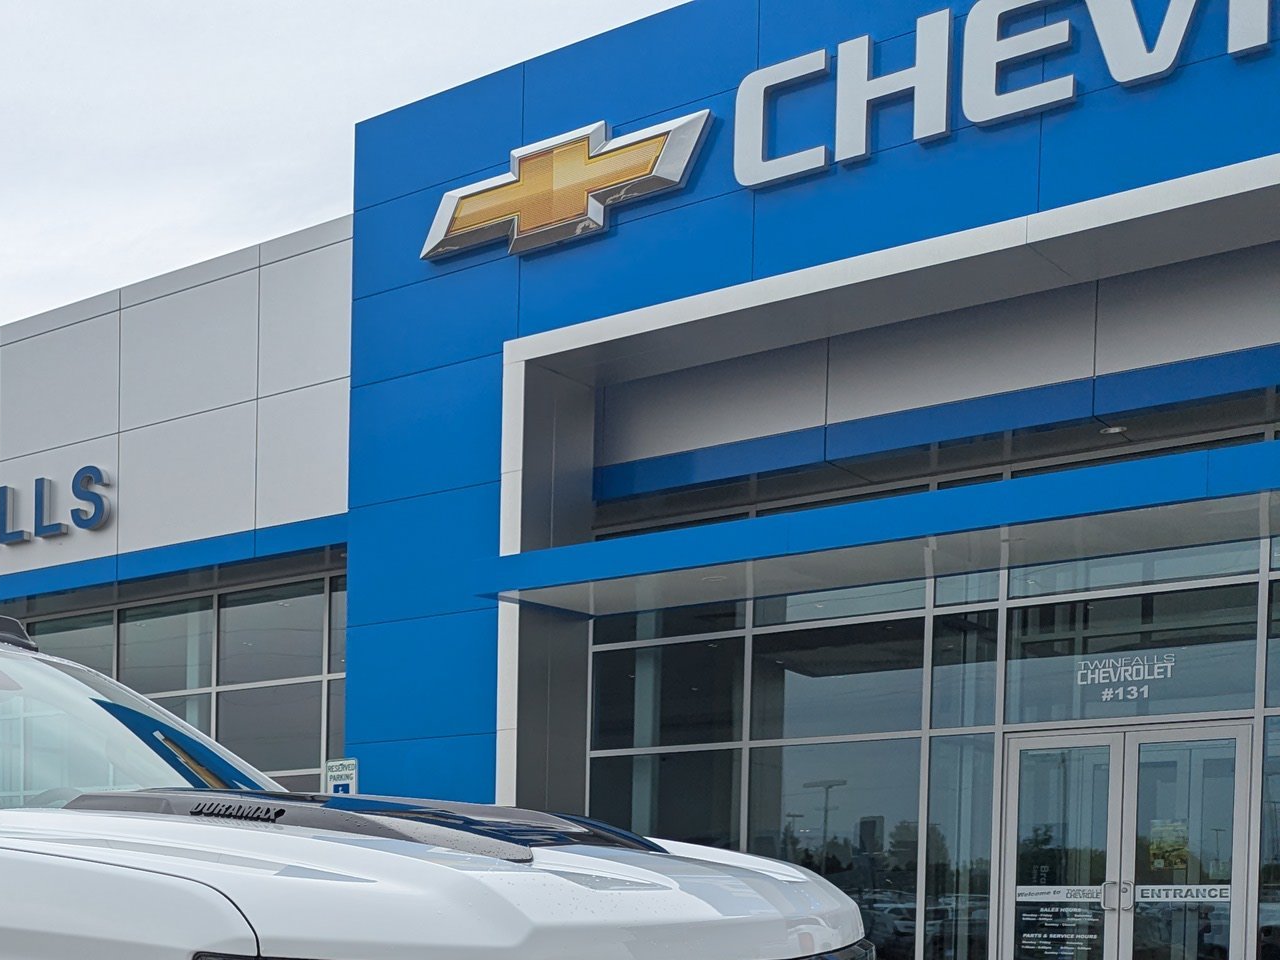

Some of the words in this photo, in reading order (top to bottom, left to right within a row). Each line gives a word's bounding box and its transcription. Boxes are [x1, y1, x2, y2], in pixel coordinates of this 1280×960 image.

[1077, 653, 1176, 671] TWINFALLS
[1077, 662, 1176, 686] CHEVROLET
[1101, 684, 1150, 702] #131
[327, 763, 356, 773] RESERVED
[328, 773, 355, 782] PARKING
[189, 801, 286, 824] DURAMAX
[1017, 890, 1052, 898] Welcome
[1065, 891, 1102, 899] CHEVROLE
[1140, 887, 1230, 900] ENTRANCE
